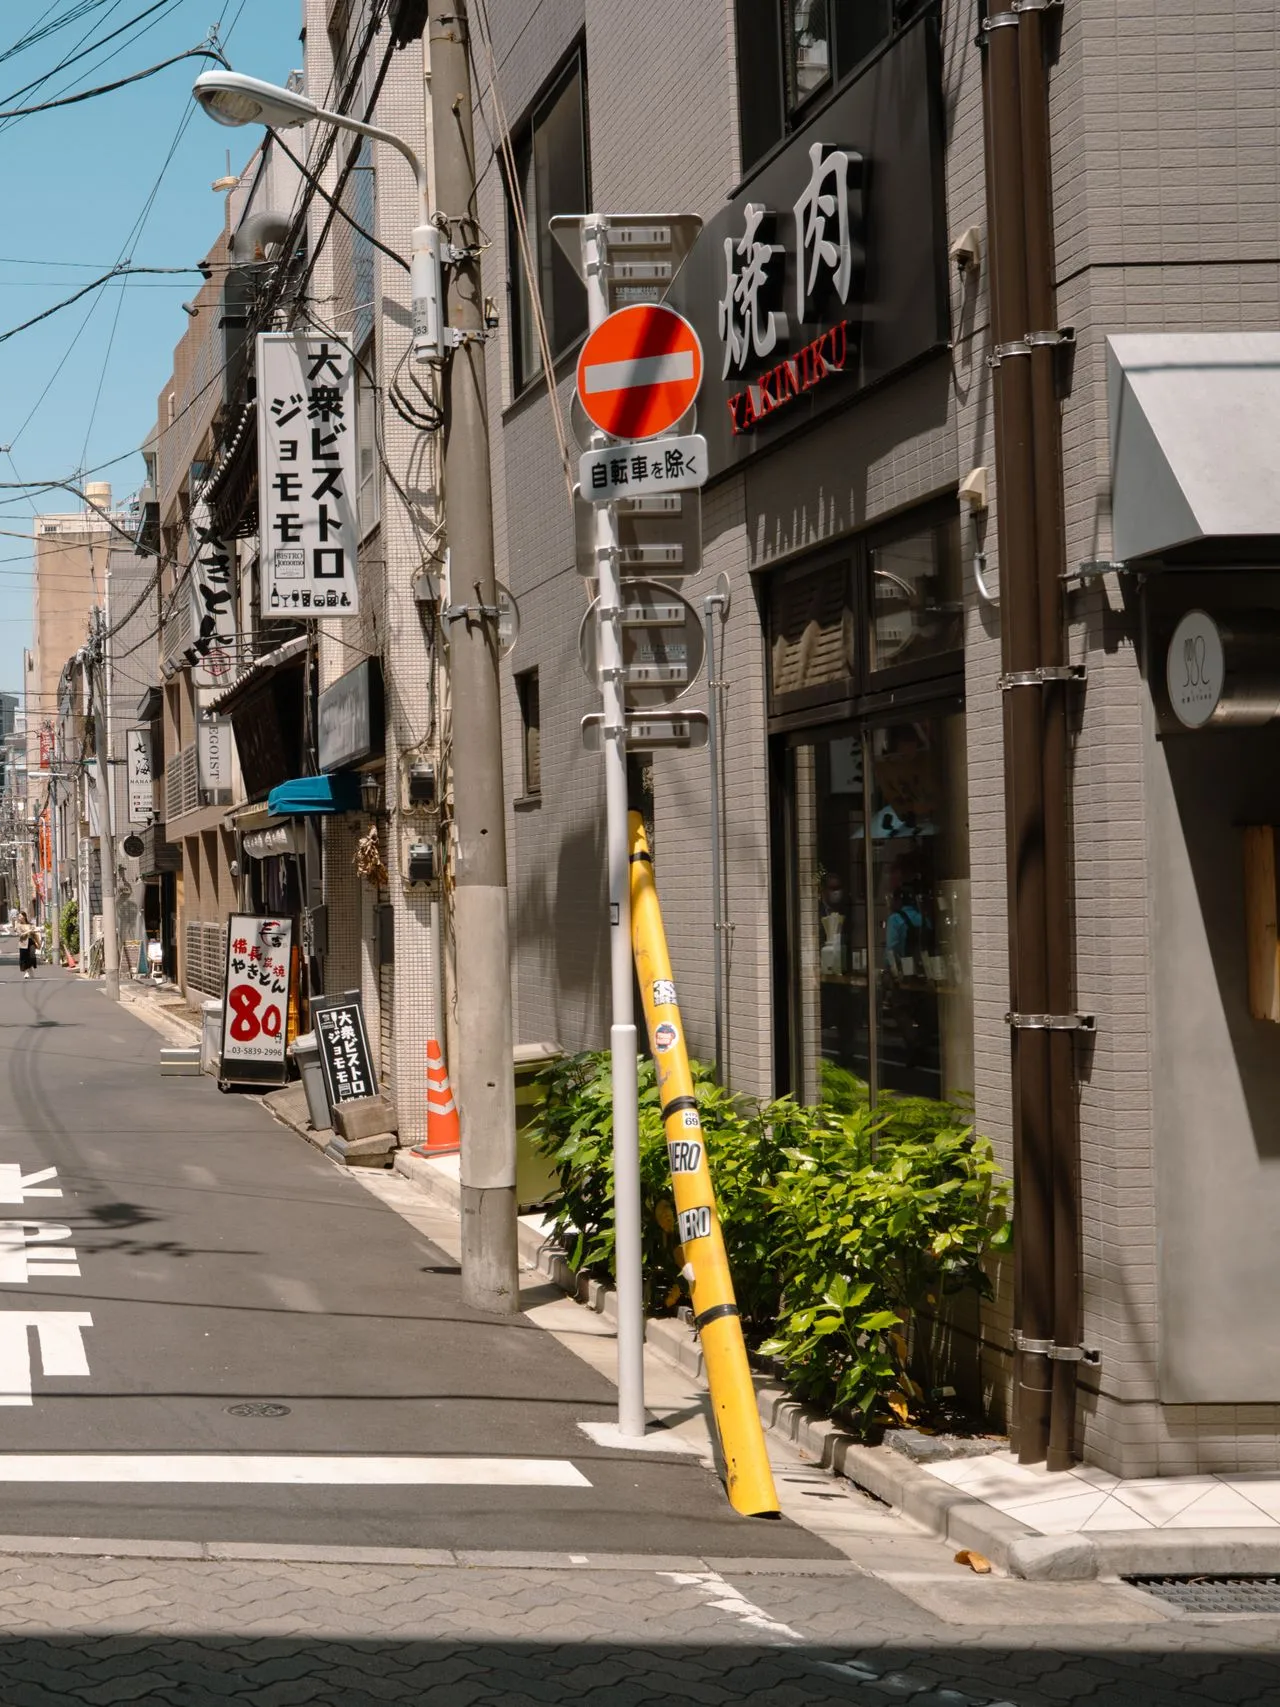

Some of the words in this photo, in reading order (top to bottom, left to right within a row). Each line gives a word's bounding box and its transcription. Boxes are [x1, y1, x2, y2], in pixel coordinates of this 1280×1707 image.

[719, 142, 851, 381] 焼肉
[728, 320, 847, 435] YAKINIKU
[270, 392, 303, 542] ジョモモ
[307, 344, 347, 578] 大衆ビストロ
[591, 449, 697, 488] 自転車を除く
[276, 552, 303, 560] BISTRO
[209, 726, 219, 777] EGOIST
[231, 958, 286, 994] やきとん
[228, 984, 282, 1042] 80
[231, 1046, 282, 1057] 03-5839-2996
[327, 1030, 349, 1083] ジョモモ
[338, 1011, 366, 1094] 大衆ビストロ
[685, 1117, 699, 1126] 69
